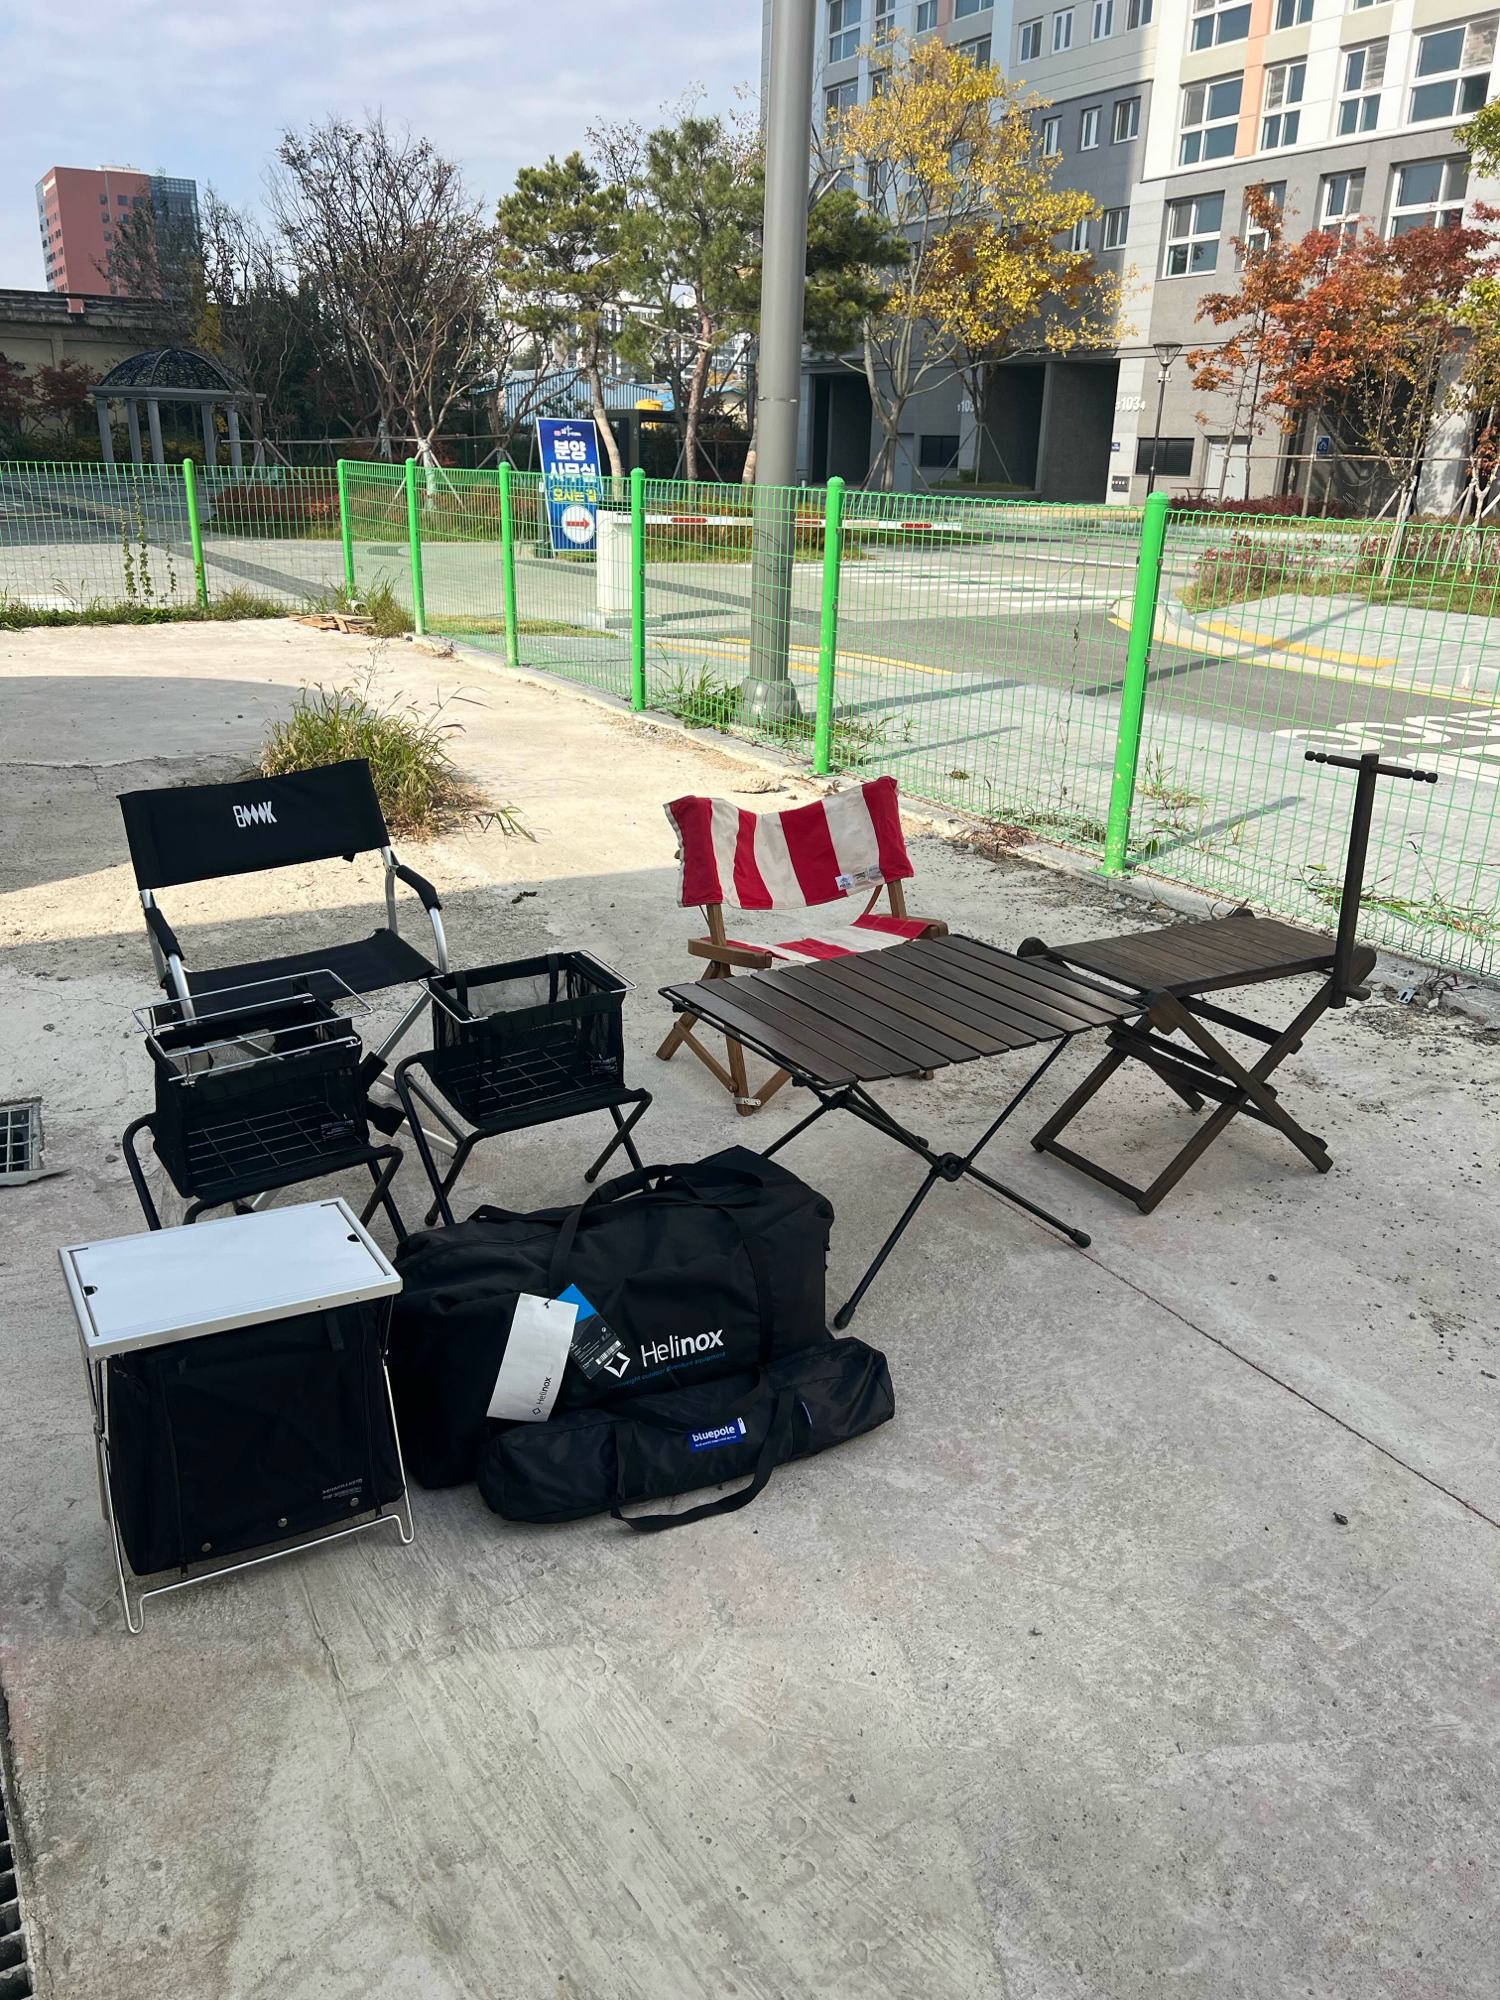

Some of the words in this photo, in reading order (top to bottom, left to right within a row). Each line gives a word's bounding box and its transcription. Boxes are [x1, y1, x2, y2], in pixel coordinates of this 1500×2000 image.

[554, 440, 587, 461] 분양
[550, 462, 597, 482] 사무실
[553, 488, 585, 502] 오시는
[586, 488, 597, 502] 길
[641, 1329, 724, 1367] Helinox
[535, 1376, 552, 1406] Helinox
[692, 1426, 735, 1442] bluepole
